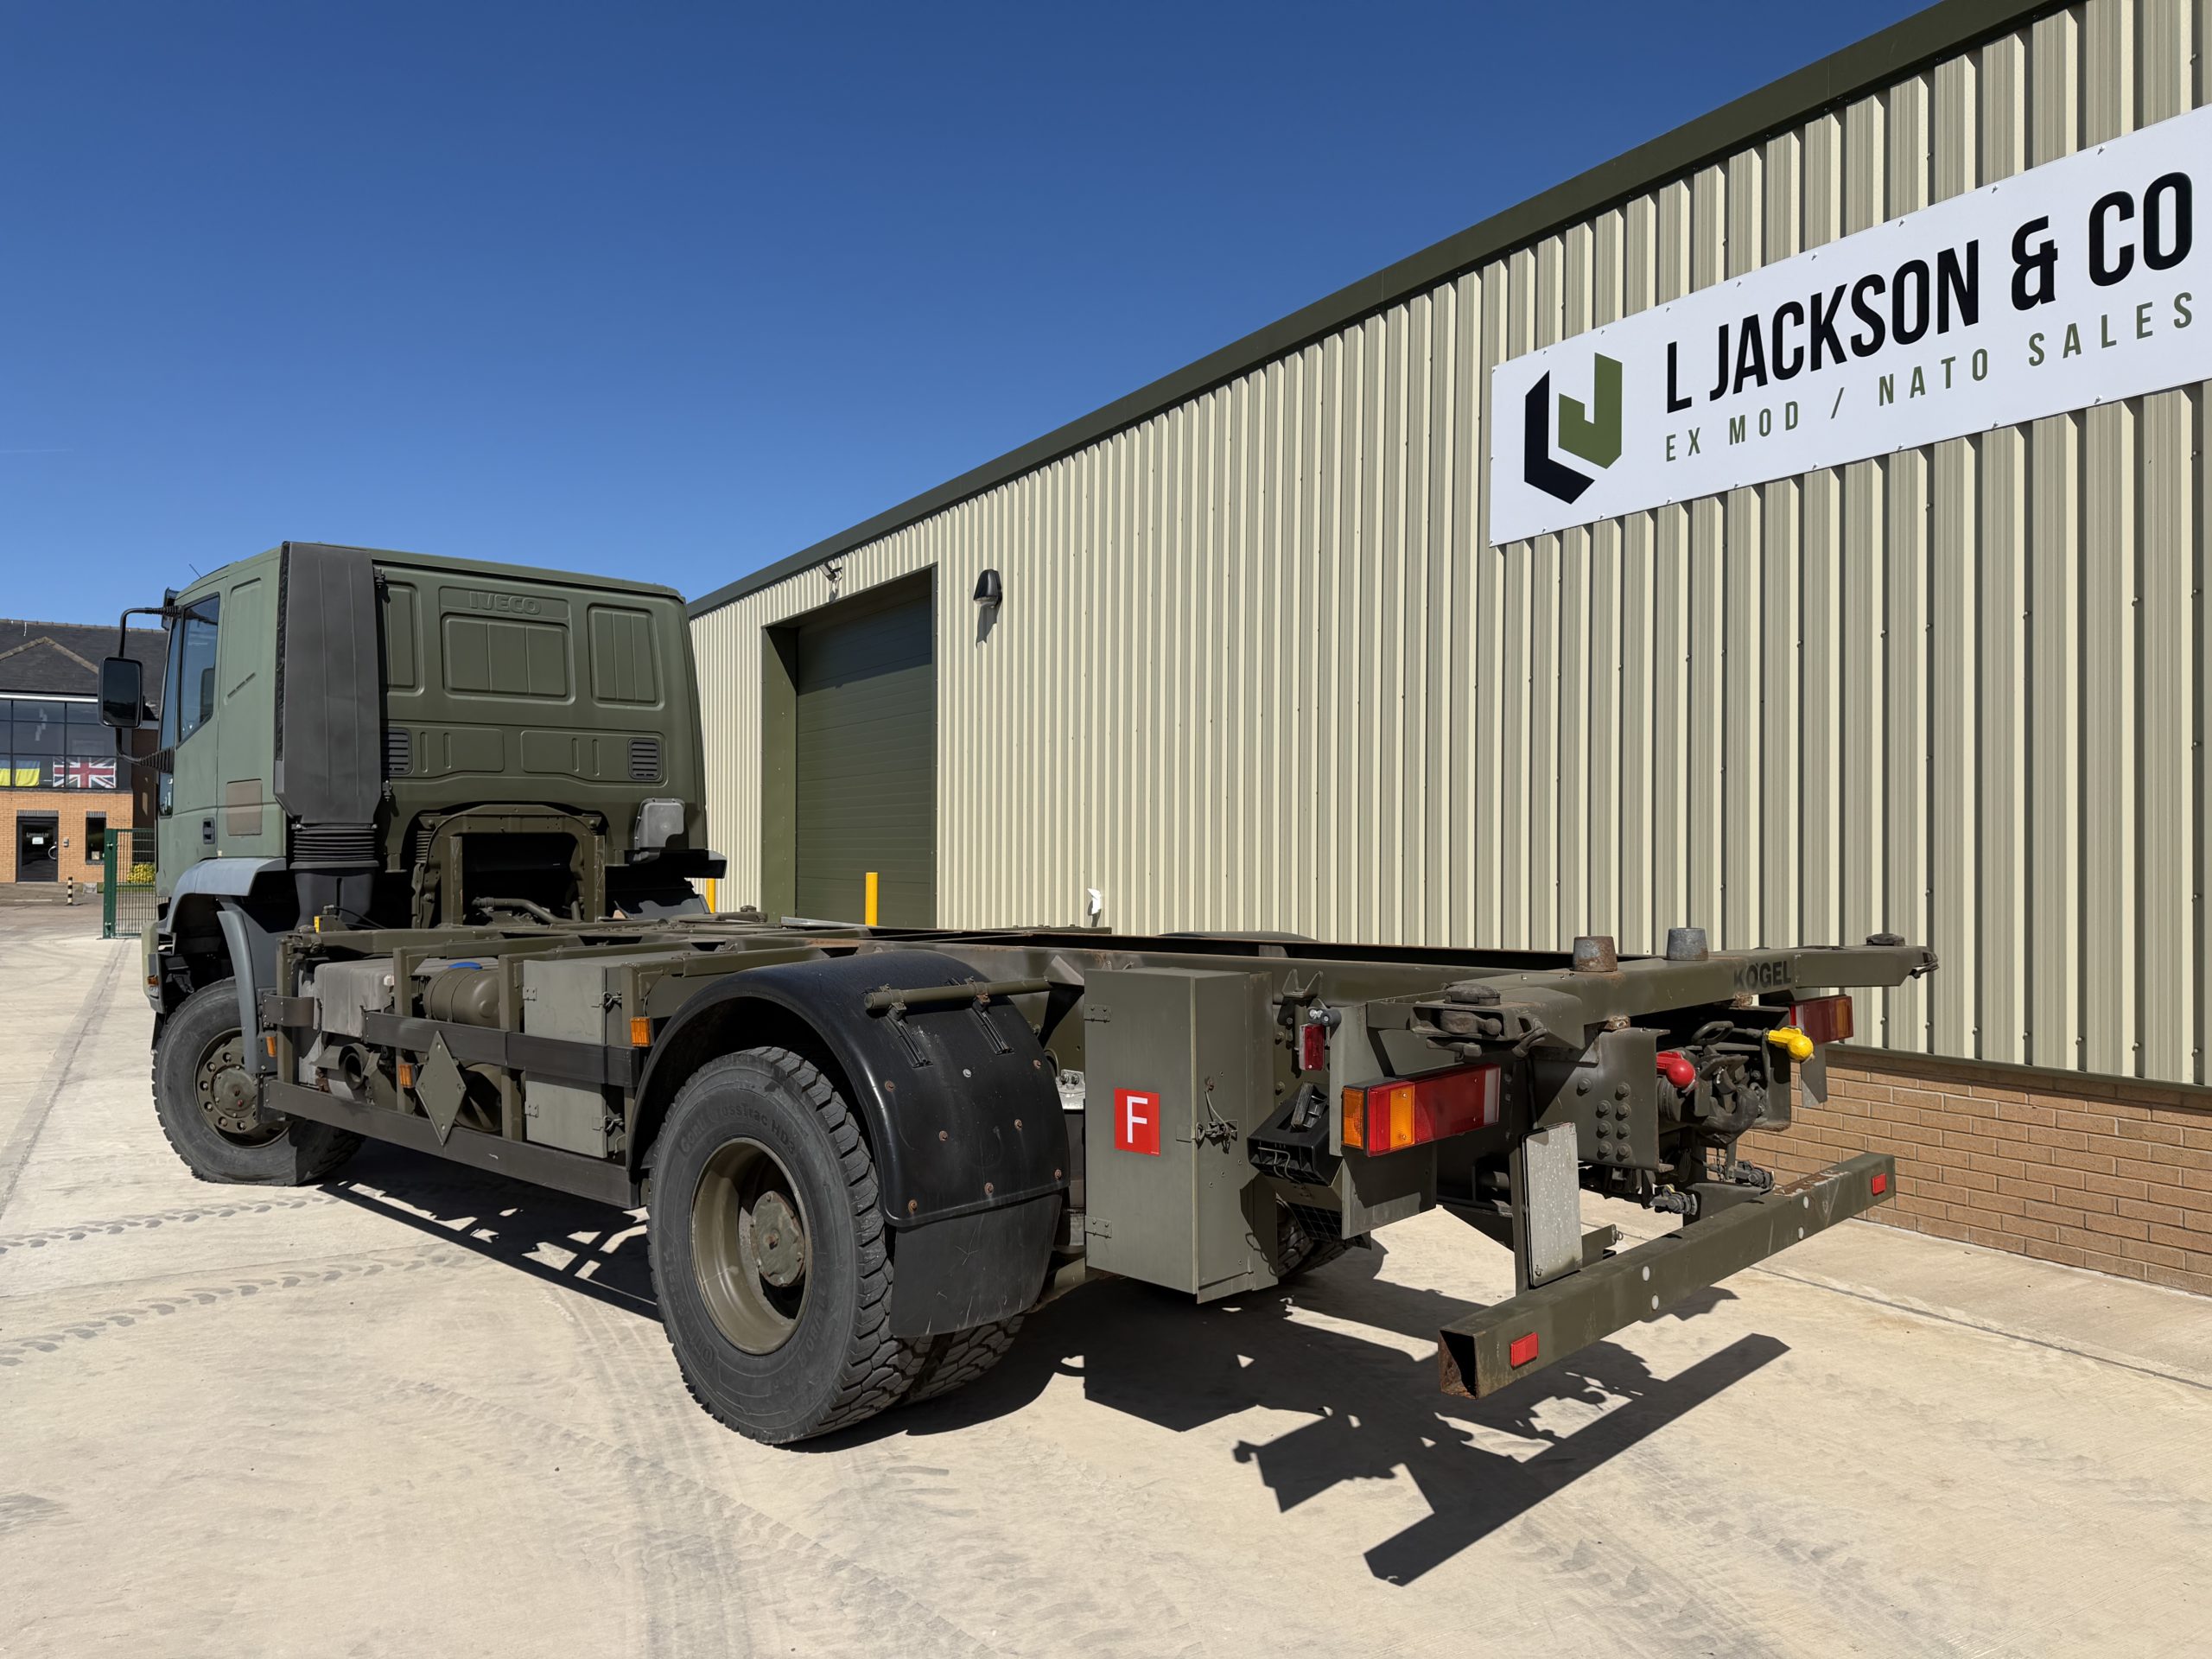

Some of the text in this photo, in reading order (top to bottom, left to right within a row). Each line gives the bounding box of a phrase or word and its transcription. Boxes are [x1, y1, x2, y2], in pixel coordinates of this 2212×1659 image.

[1666, 171, 2193, 414] L JACKSON & CO
[1666, 291, 2192, 462] EX MOD / NATO SALES
[469, 590, 542, 615] IVECO
[771, 1119, 797, 1155] HD3
[1126, 1095, 1148, 1144] F
